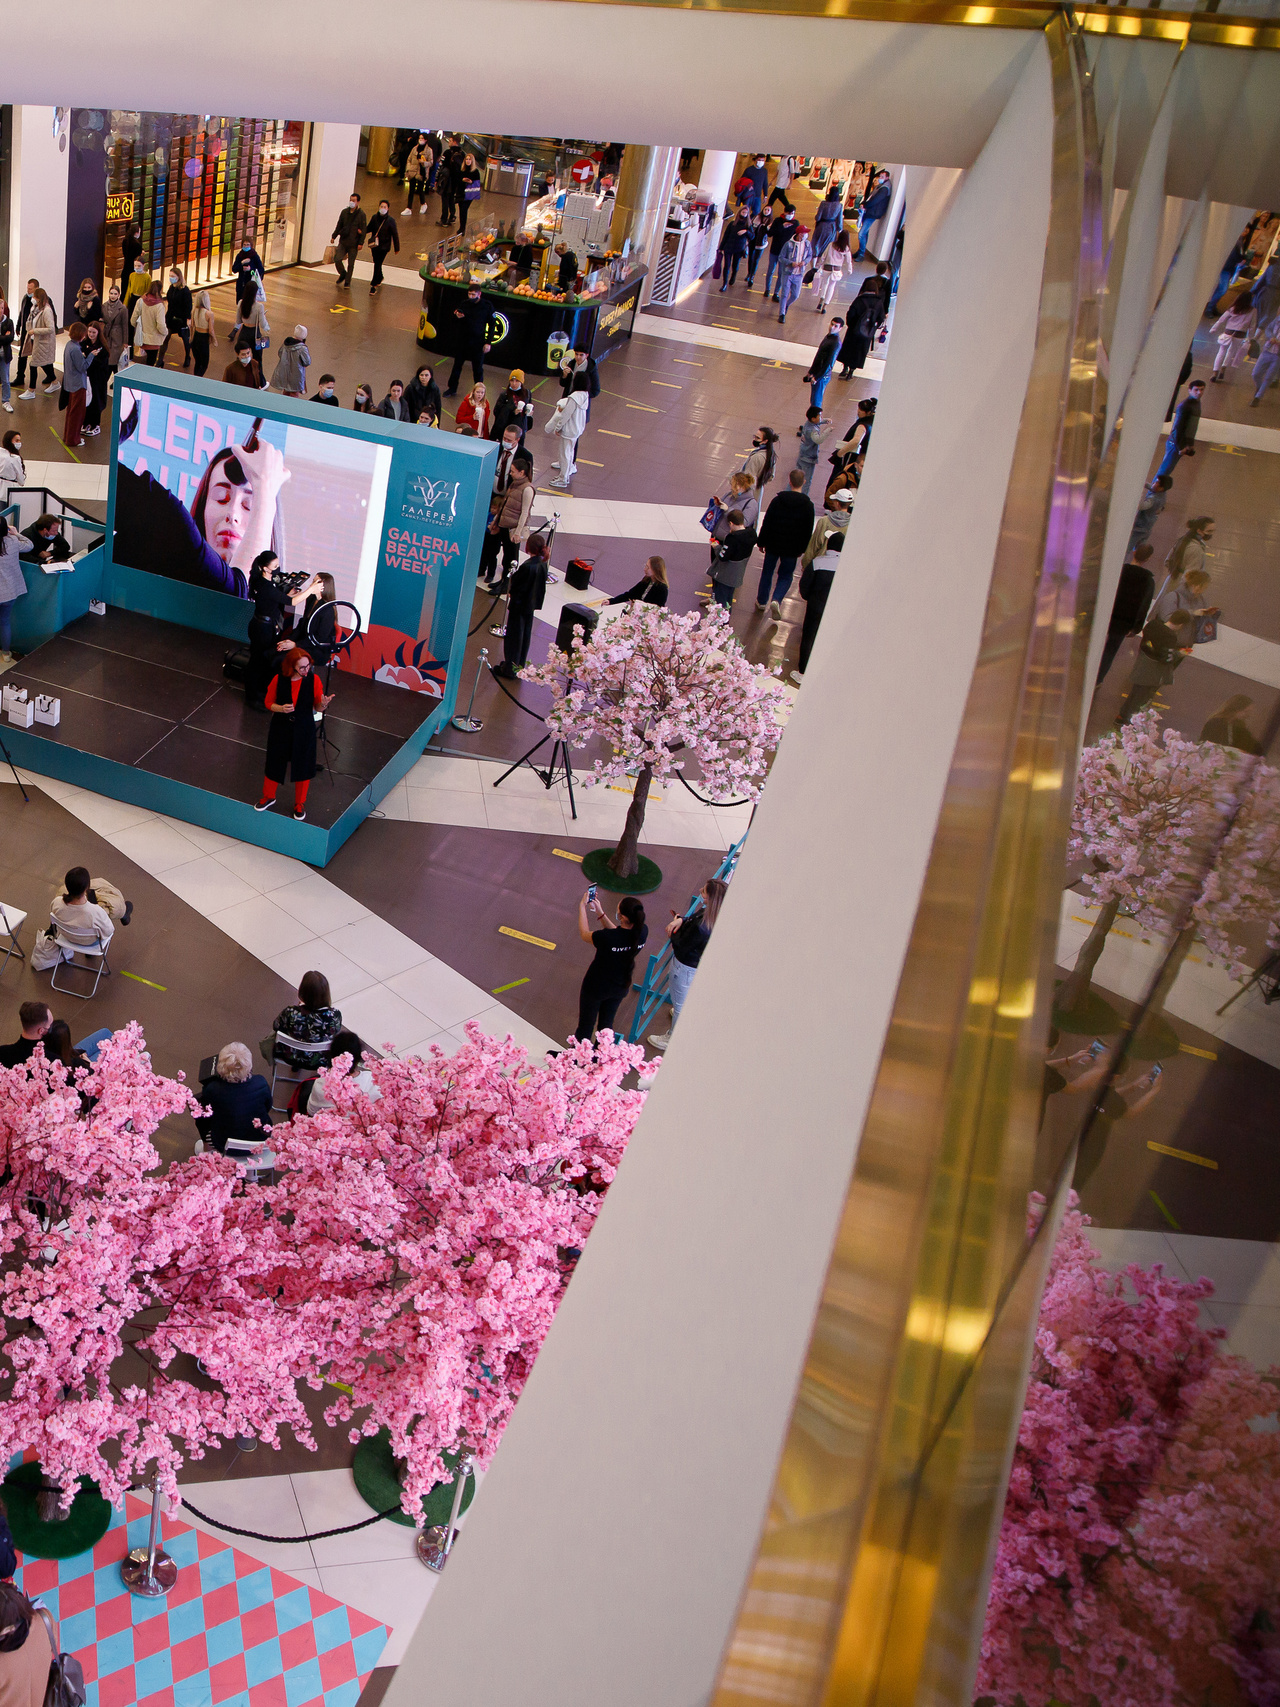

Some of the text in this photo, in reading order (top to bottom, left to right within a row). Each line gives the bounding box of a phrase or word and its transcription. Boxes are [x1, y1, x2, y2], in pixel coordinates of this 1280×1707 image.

[402, 504, 454, 522] ГАЛЕРЕЯ
[386, 540, 452, 567] BEAUTY
[388, 527, 460, 556] GALERIA
[385, 553, 434, 577] WEEK
